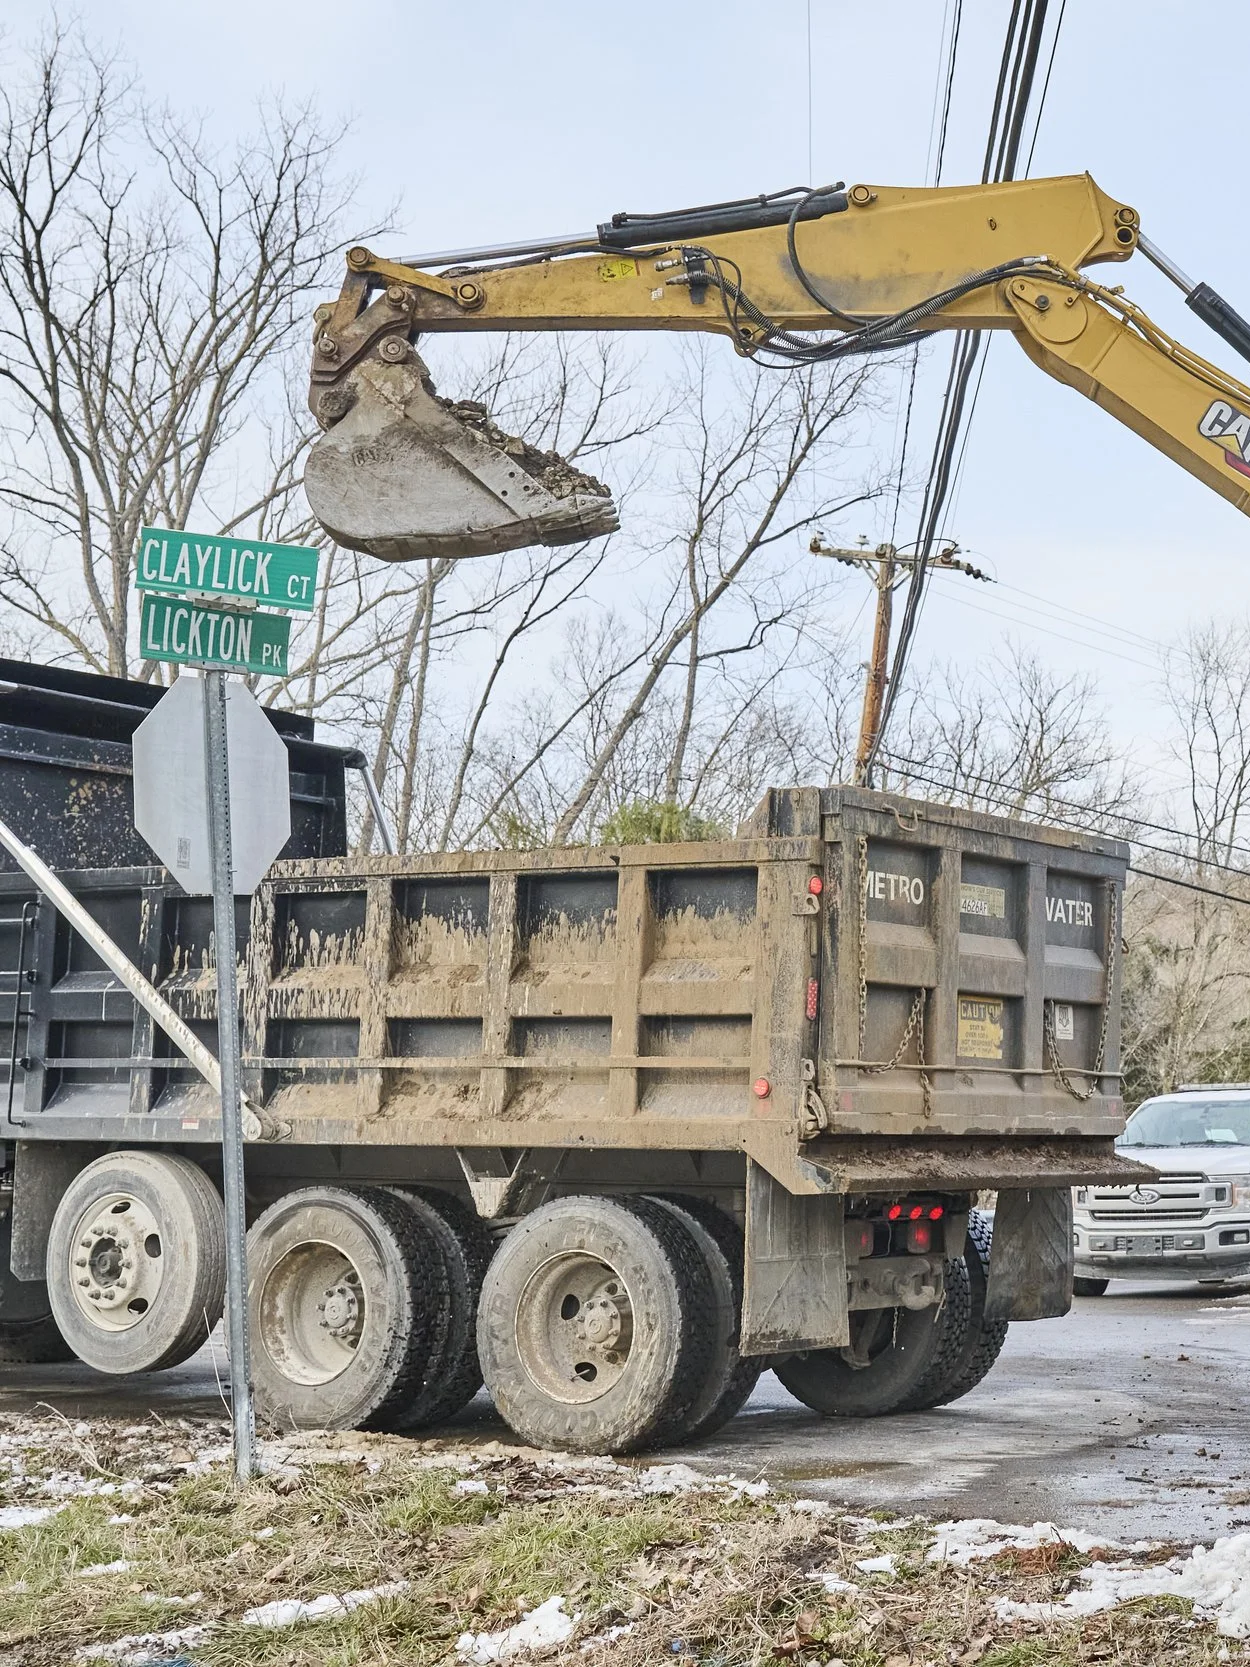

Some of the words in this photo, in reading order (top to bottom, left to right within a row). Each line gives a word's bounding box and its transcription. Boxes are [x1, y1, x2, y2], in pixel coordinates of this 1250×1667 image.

[142, 538, 273, 595] CLAYLICK
[287, 574, 311, 600] CT
[147, 603, 253, 663] LICKTON
[262, 643, 282, 668] PK
